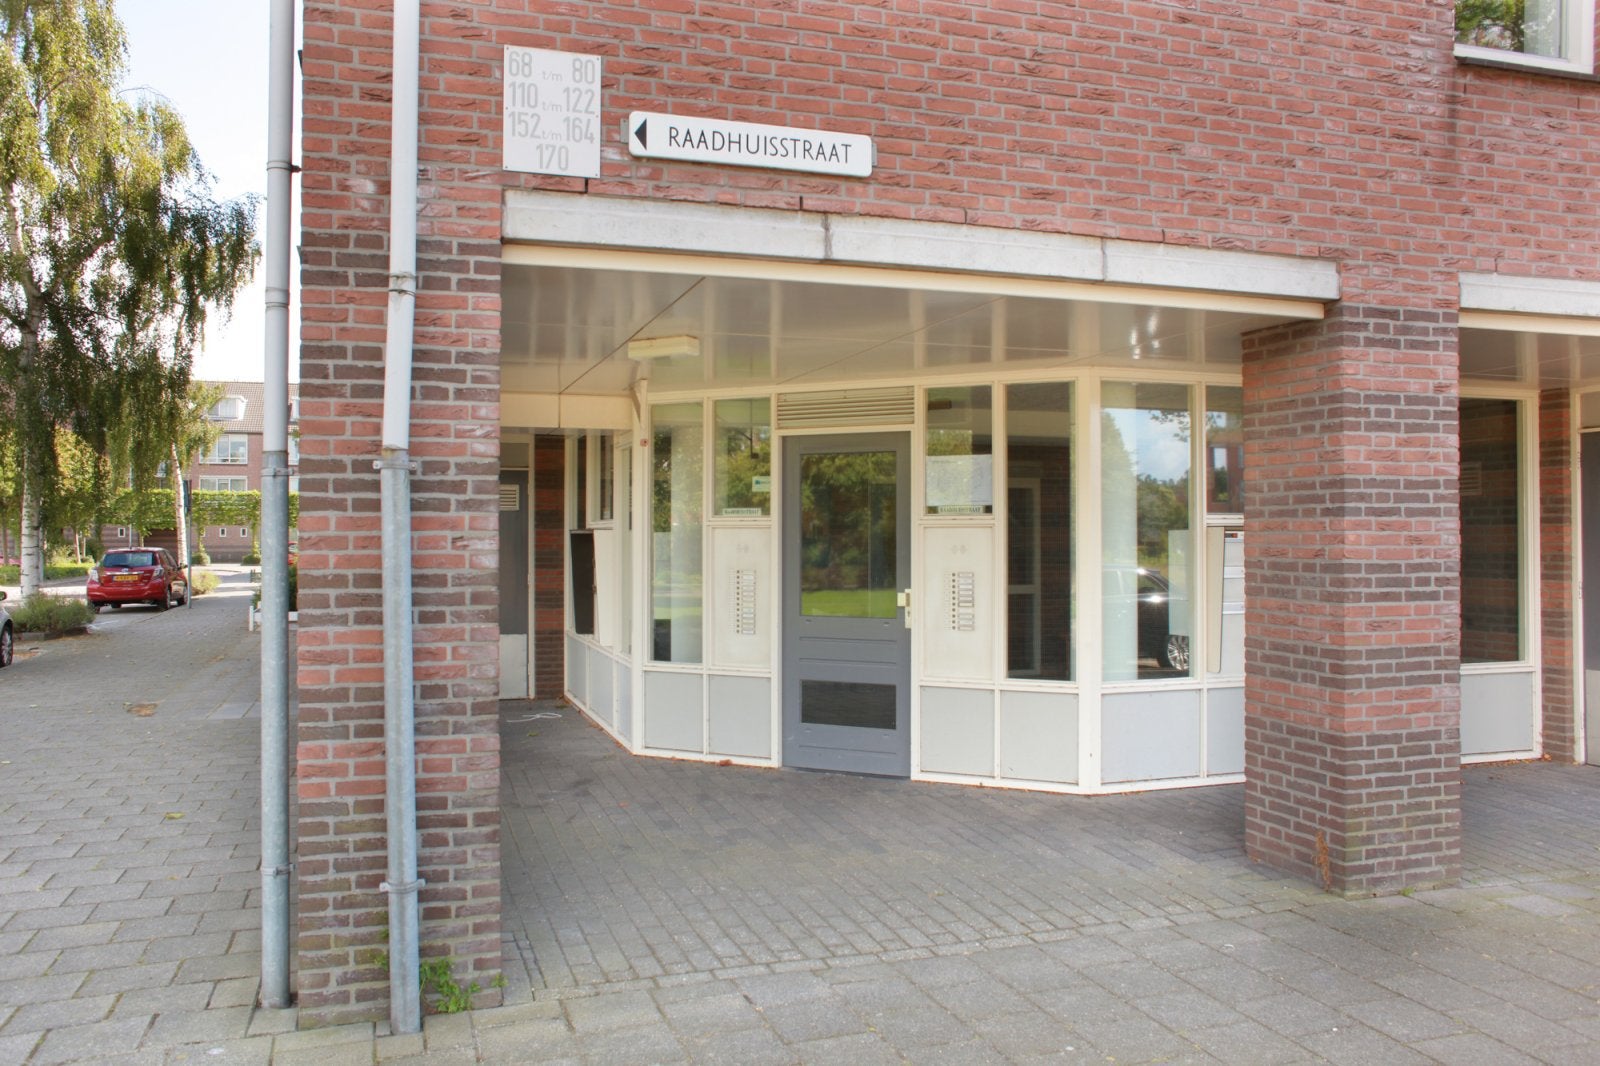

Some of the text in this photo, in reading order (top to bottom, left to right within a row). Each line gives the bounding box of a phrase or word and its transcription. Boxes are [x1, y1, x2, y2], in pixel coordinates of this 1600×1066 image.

[508, 51, 596, 85] 68 t/m 80
[508, 81, 595, 115] 110 t/m 122
[508, 111, 595, 144] 152 t/m 164
[536, 143, 569, 171] 170
[668, 126, 852, 164] RAADHUISSTRAAT
